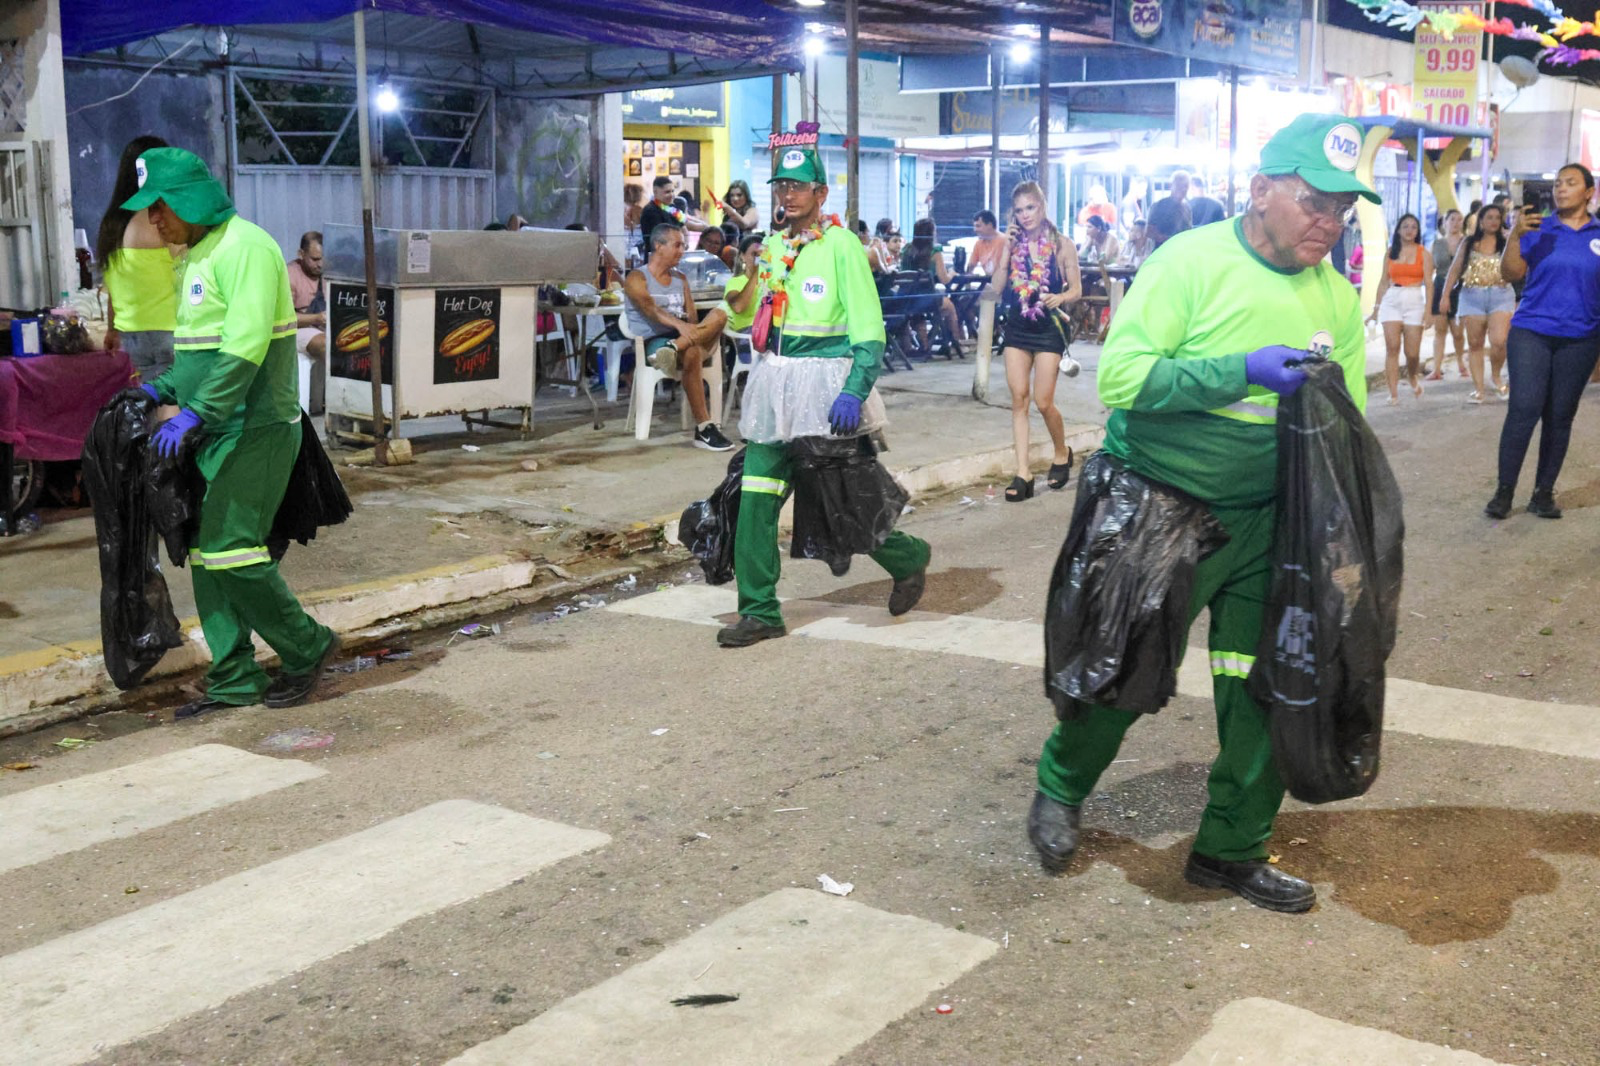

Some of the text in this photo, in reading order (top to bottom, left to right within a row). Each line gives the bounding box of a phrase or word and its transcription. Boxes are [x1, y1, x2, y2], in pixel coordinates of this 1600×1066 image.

[1419, 34, 1437, 44] SELF
[1427, 48, 1475, 73] 9,99
[1423, 88, 1465, 99] SALGADO
[1330, 134, 1358, 157] MB
[137, 166, 145, 177] B
[804, 282, 824, 294] MB
[337, 291, 359, 307] Hot
[443, 296, 493, 316] Hot Dog
[455, 343, 492, 379] Enjoy!
